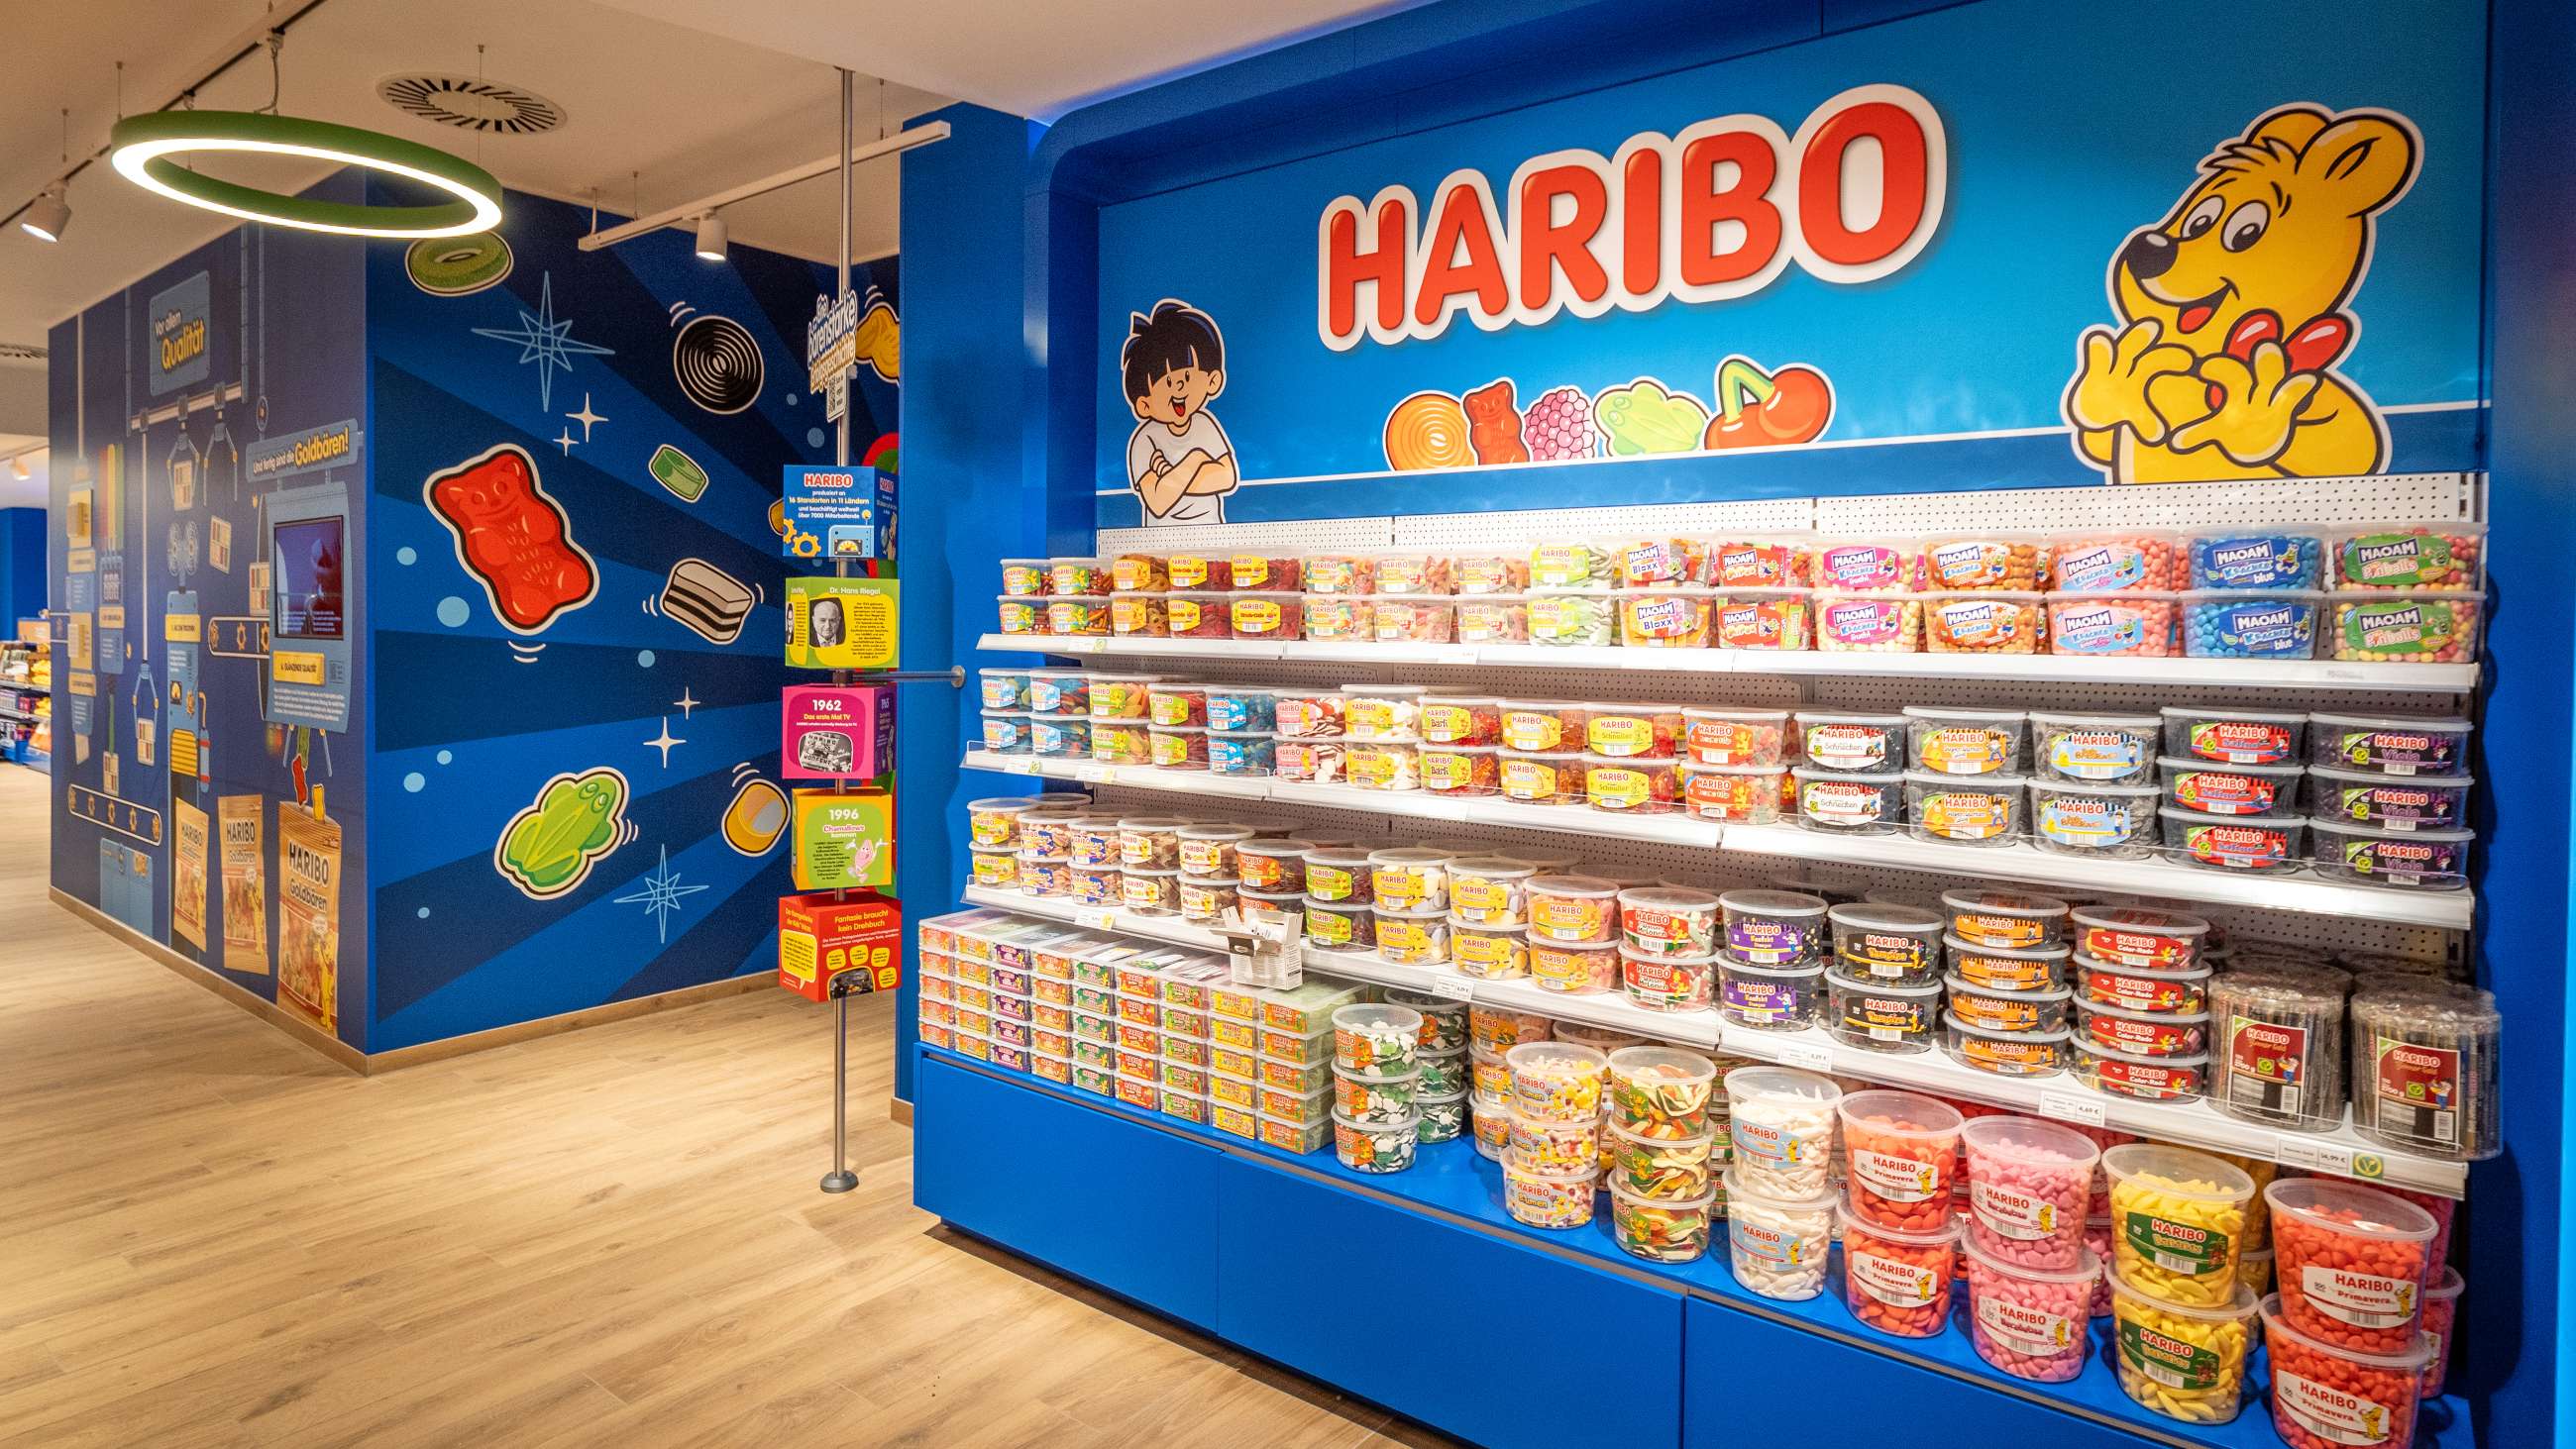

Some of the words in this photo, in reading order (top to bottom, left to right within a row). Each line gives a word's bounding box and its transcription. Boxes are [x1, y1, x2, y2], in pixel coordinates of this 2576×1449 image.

[1319, 84, 1948, 353] HARIBO
[161, 319, 205, 369] Qualität
[295, 427, 349, 466] Goldbären!
[805, 473, 853, 486] HARIBO
[1628, 547, 1659, 563] MAOAM
[1723, 551, 1757, 565] MAOAM
[1833, 550, 1876, 568] MAOAM
[1939, 547, 1981, 567] MAOAM
[2213, 541, 2273, 568] MAOAM
[2358, 538, 2419, 565] MAOAM
[1632, 563, 1658, 574] Bloxx
[2066, 551, 2110, 574] MAOAM
[2362, 560, 2418, 579] Pinballs
[2254, 571, 2275, 583] blue
[1638, 603, 1675, 618] MAOAM
[1723, 609, 1757, 625] MAOAM
[1835, 606, 1877, 623] MAOAM
[1947, 605, 1991, 625] MAOAM
[1643, 619, 1672, 630] Bloxx
[2066, 611, 2112, 632] MAOAM
[2233, 606, 2293, 632] MAOAM
[2359, 607, 2421, 631] MAOAM
[2274, 638, 2294, 650] blue
[2364, 628, 2420, 647] Pinballs
[812, 700, 841, 711] 1962
[1208, 699, 1230, 708] HARIBO
[1351, 703, 1376, 712] HARIBO
[1600, 720, 1633, 729] HARIBO
[2220, 726, 2268, 738] HARIBO
[1823, 730, 1864, 739] HARIBO
[1942, 733, 1986, 743] HARIBO
[2073, 735, 2120, 746] HARIBO
[1824, 743, 1864, 752] Schnecken
[2375, 735, 2428, 751] HARIBO
[2381, 750, 2421, 762] Viola
[1820, 785, 1860, 795] HARIBO
[2199, 776, 2247, 789] HARIBO
[1820, 799, 1859, 808] Schnecken
[1945, 797, 1987, 808] HARIBO
[2374, 790, 2428, 805] HARIBO
[828, 809, 859, 820] 1996
[2381, 805, 2420, 818] Viola
[182, 822, 202, 847] HARIBO
[226, 820, 255, 843] HARIBO
[2378, 844, 2432, 859] HARIBO
[288, 842, 329, 886] HARIBO
[1242, 856, 1264, 865] HARIBO
[2385, 859, 2424, 872] Viola
[1311, 869, 1335, 878] HARIBO
[289, 880, 327, 909] Goldbären
[1459, 885, 1489, 895] HARIBO
[835, 913, 862, 923] Fantasie
[863, 909, 889, 920] braucht
[1311, 913, 1335, 922] HARIBO
[838, 923, 852, 932] kein
[854, 920, 885, 930] Drehbuch
[1462, 940, 1491, 949] HARIBO
[1866, 934, 1908, 948] HARIBO
[2117, 945, 2155, 955] Color-Rado
[2116, 987, 2154, 999] Color-Rado
[1865, 998, 1907, 1012] HARIBO
[2116, 1032, 2154, 1043] Color-Rado
[2247, 1028, 2290, 1046] HARIBO
[2393, 1051, 2440, 1069] HARIBO
[2129, 1076, 2166, 1087] Color-Rado
[1742, 1124, 1778, 1141] HARIBO
[1873, 1156, 1916, 1173] HARIBO
[1986, 1188, 2029, 1210] HARIBO
[1743, 1224, 1780, 1243] HARIBO
[2151, 1219, 2206, 1242] HARIBO
[1872, 1259, 1915, 1278] HARIBO
[2335, 1273, 2394, 1293] HARIBO
[1999, 1304, 2047, 1326] HARIBO
[2140, 1328, 2193, 1358] HARIBO
[2300, 1382, 2357, 1410] HARIBO
